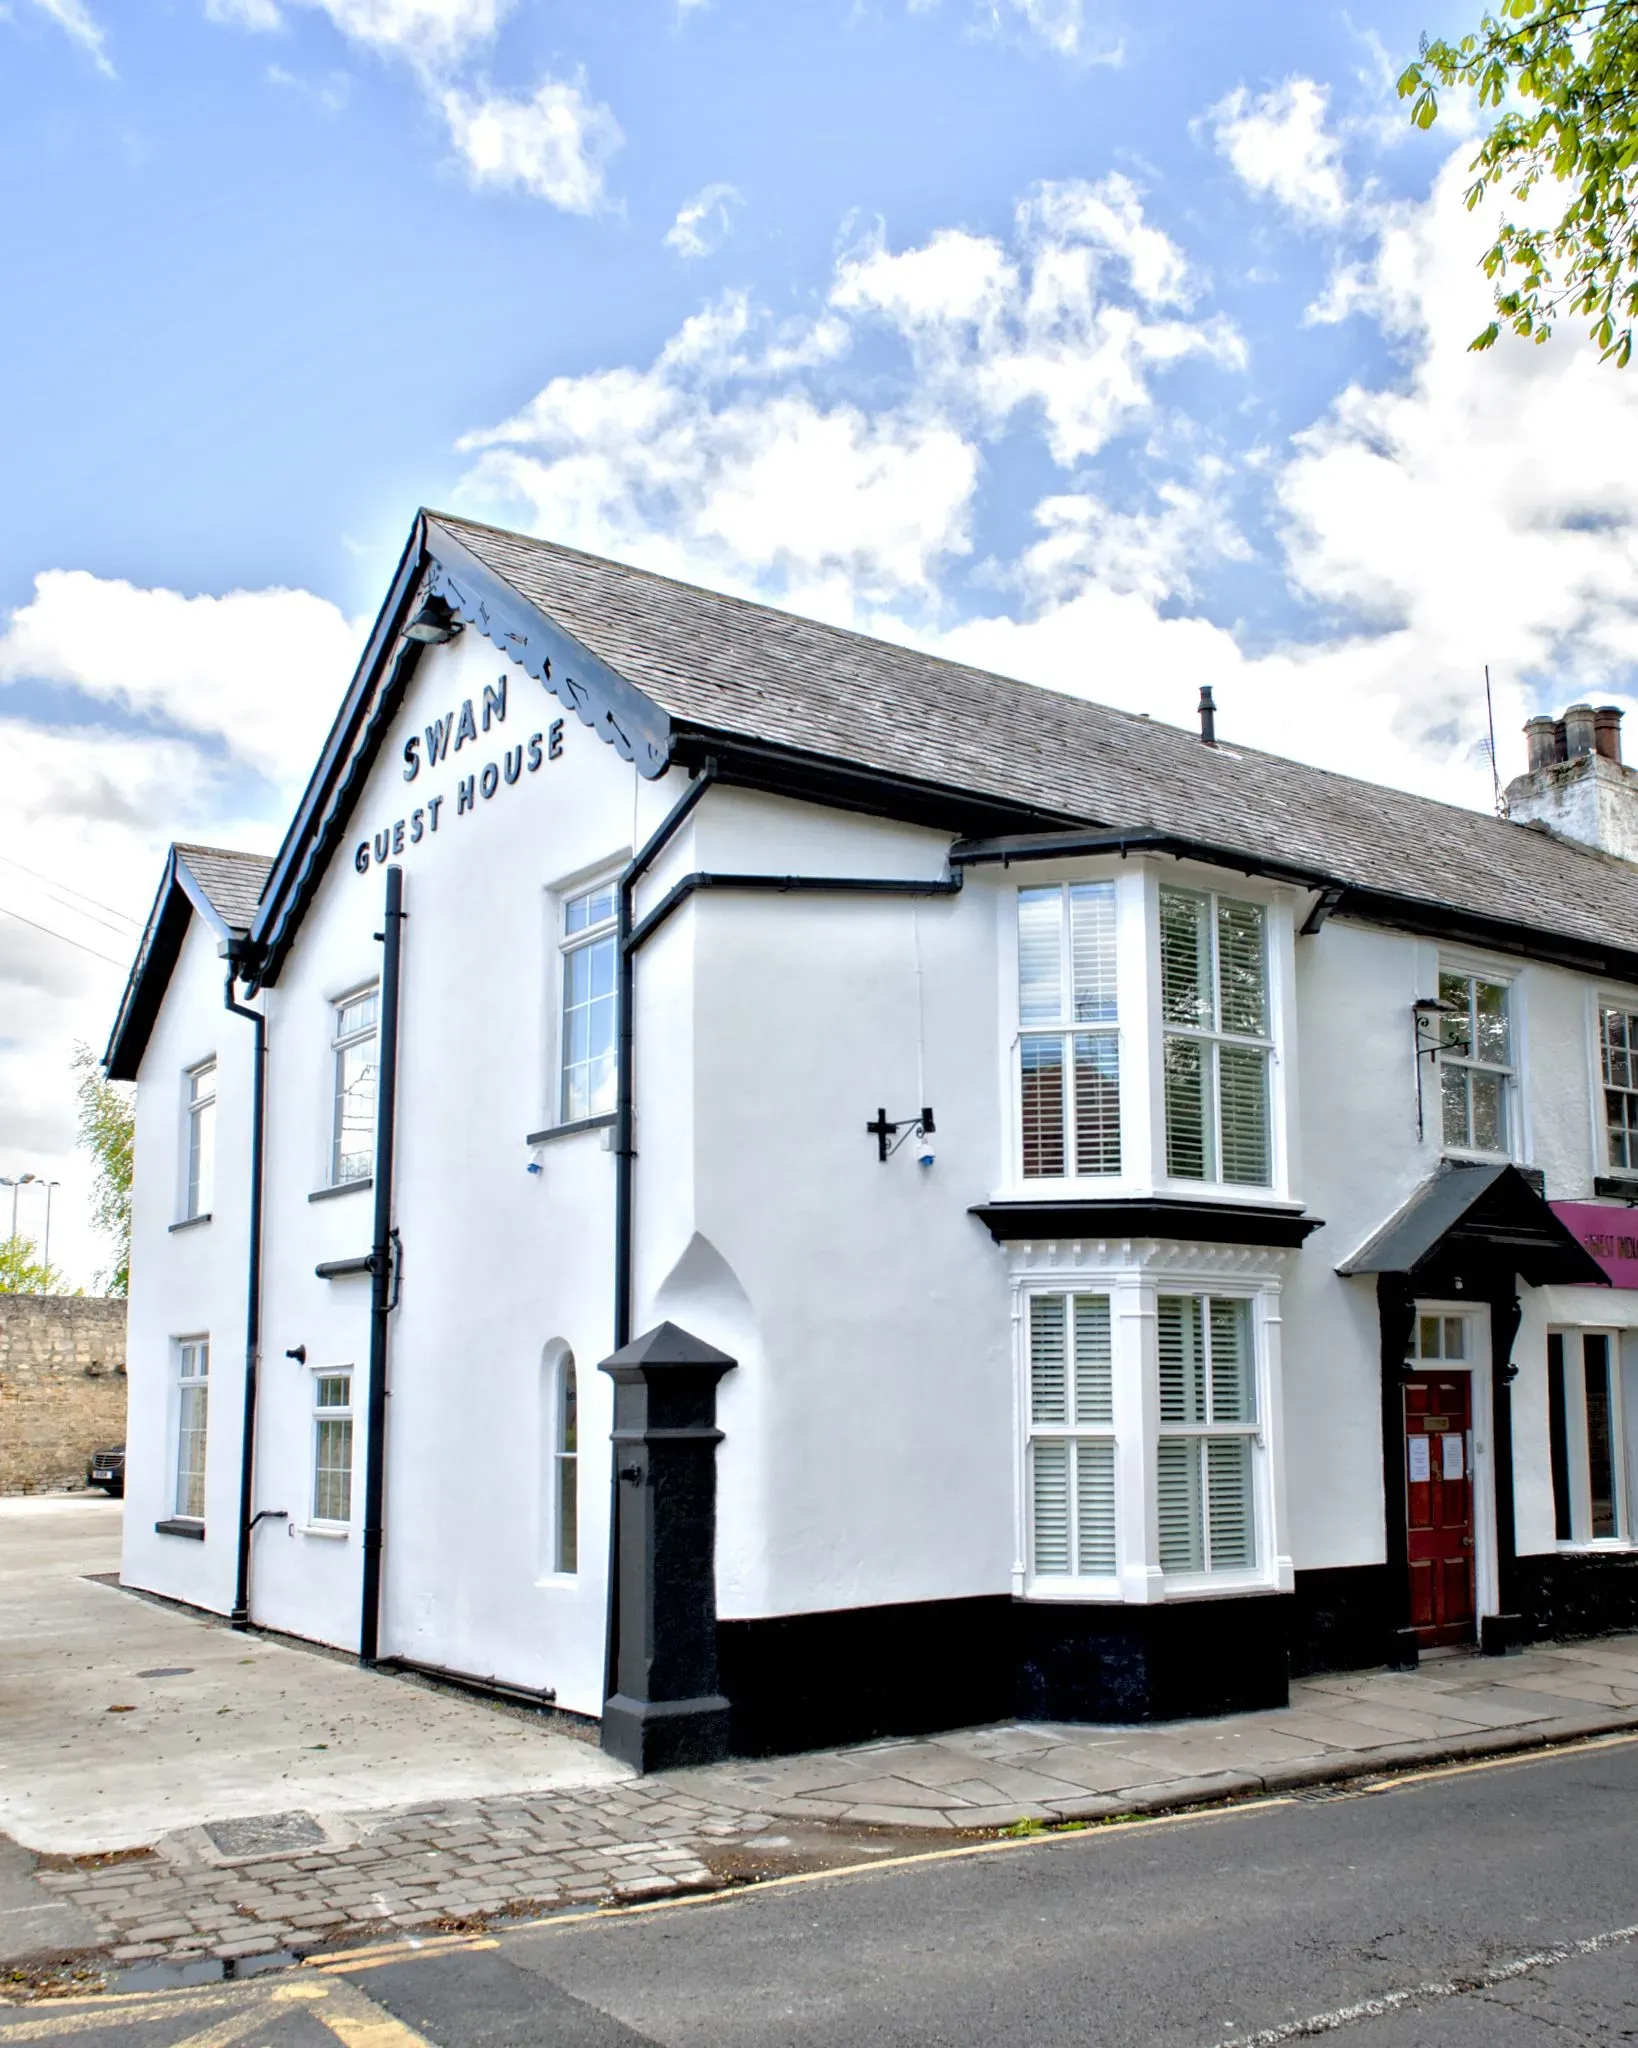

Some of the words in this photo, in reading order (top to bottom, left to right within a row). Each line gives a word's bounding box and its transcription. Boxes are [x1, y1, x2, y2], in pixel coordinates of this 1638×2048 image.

[403, 674, 507, 782] SWAN
[355, 795, 444, 874] GUEST
[457, 718, 564, 816] HOUSE
